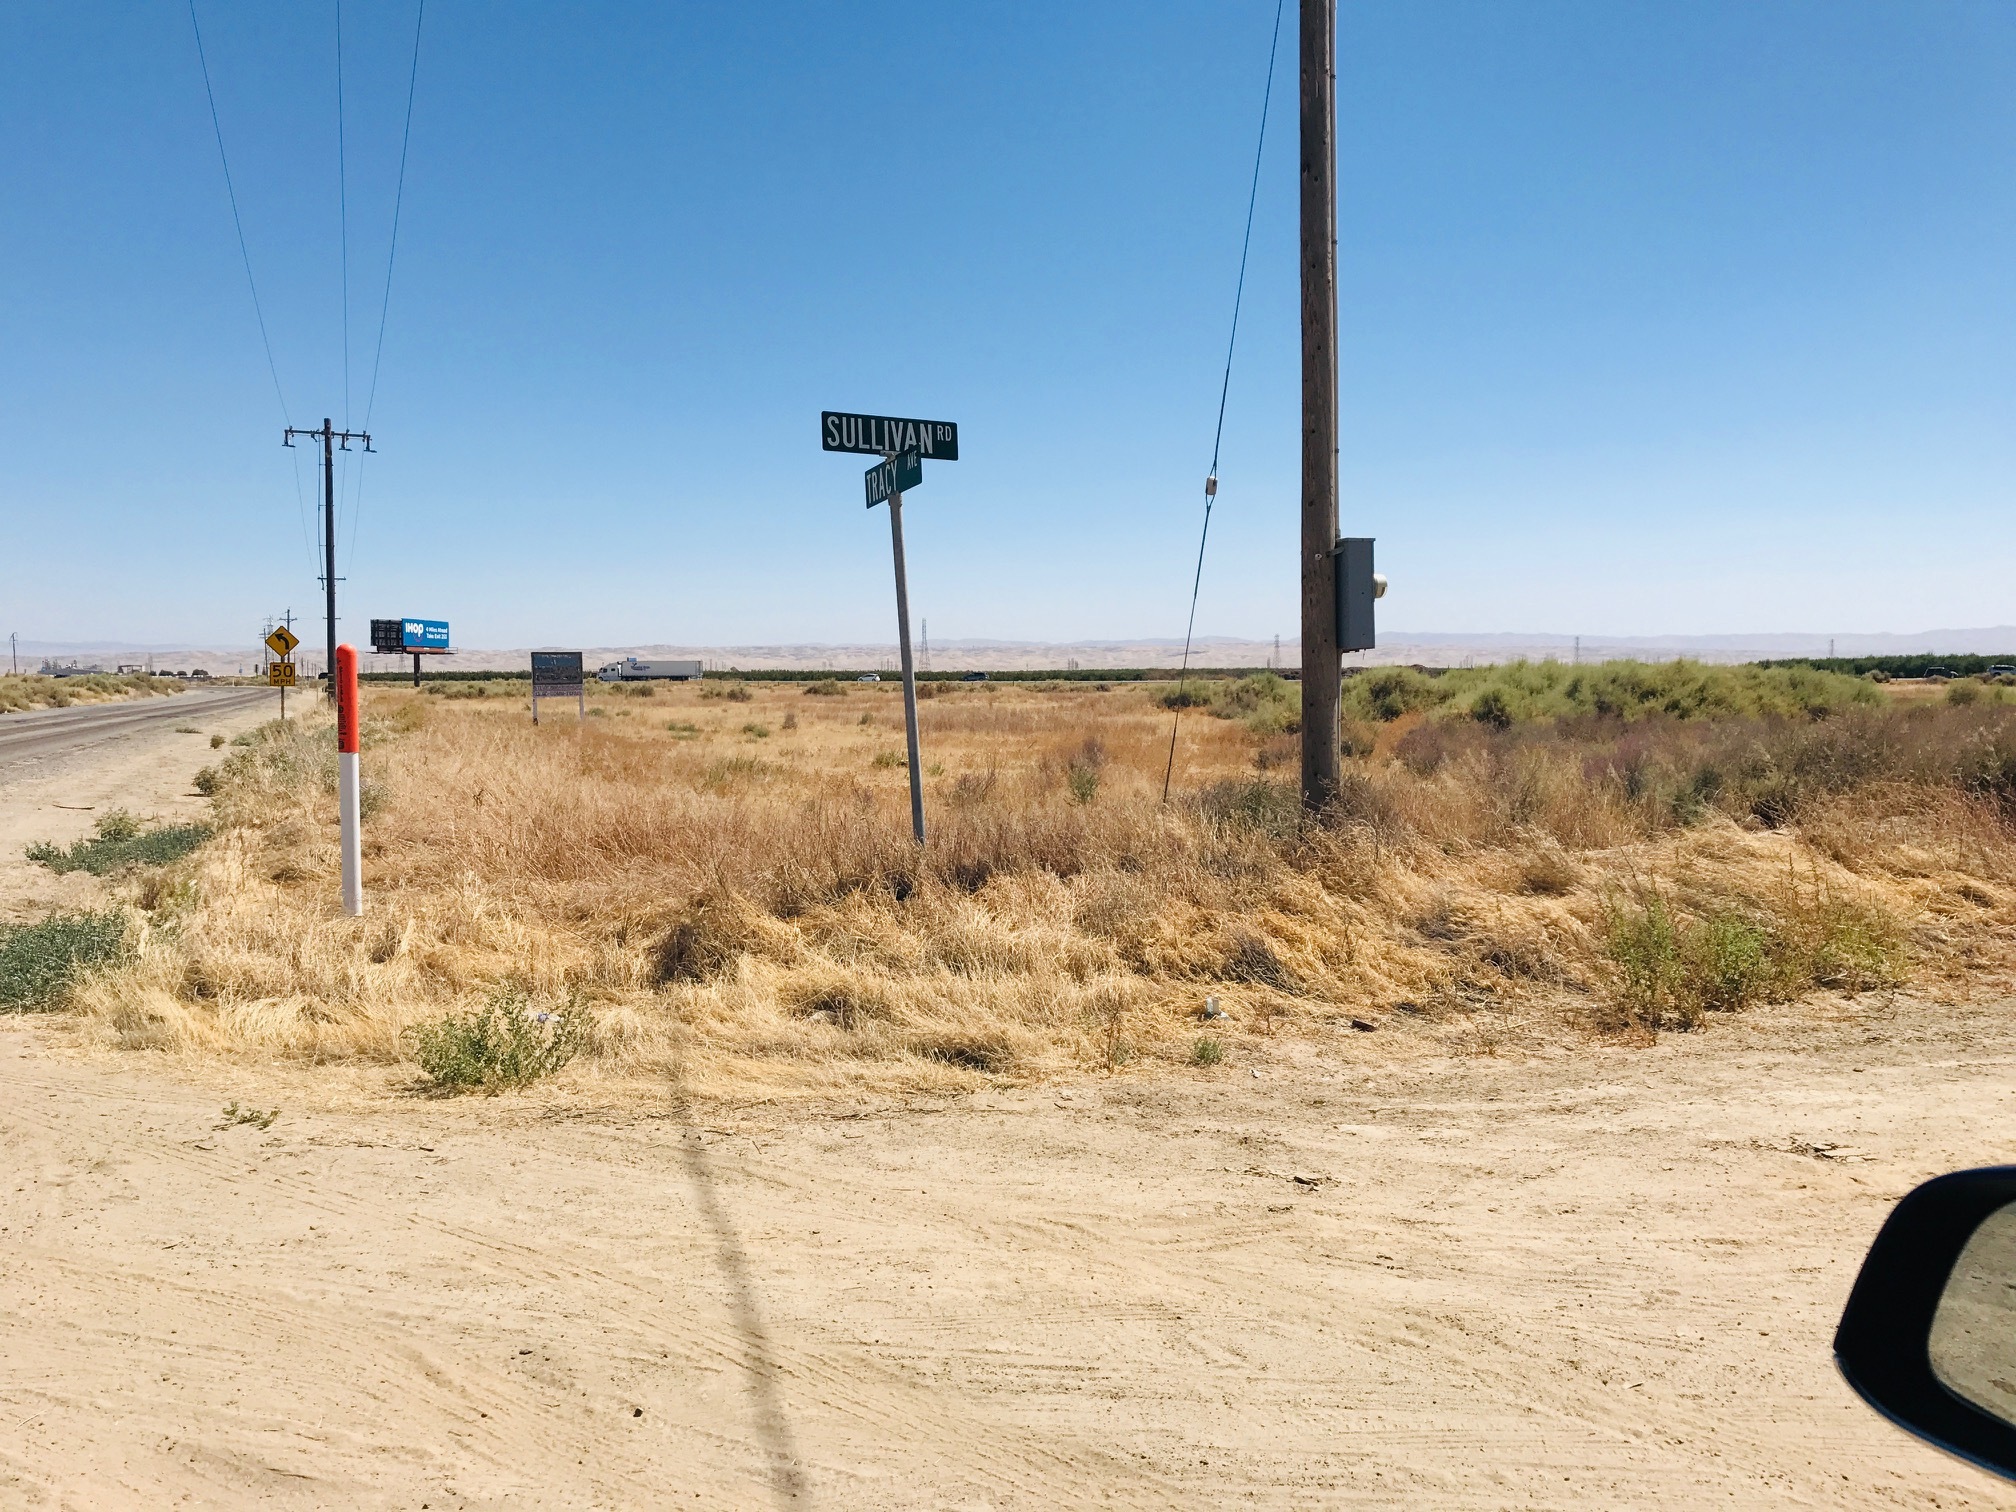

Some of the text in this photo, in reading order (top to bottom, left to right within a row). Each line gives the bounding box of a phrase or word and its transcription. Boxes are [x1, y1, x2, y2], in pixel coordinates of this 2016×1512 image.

[827, 415, 952, 454] SULLIVAN RD
[866, 450, 917, 504] TRACY AVE
[272, 665, 293, 678] 50
